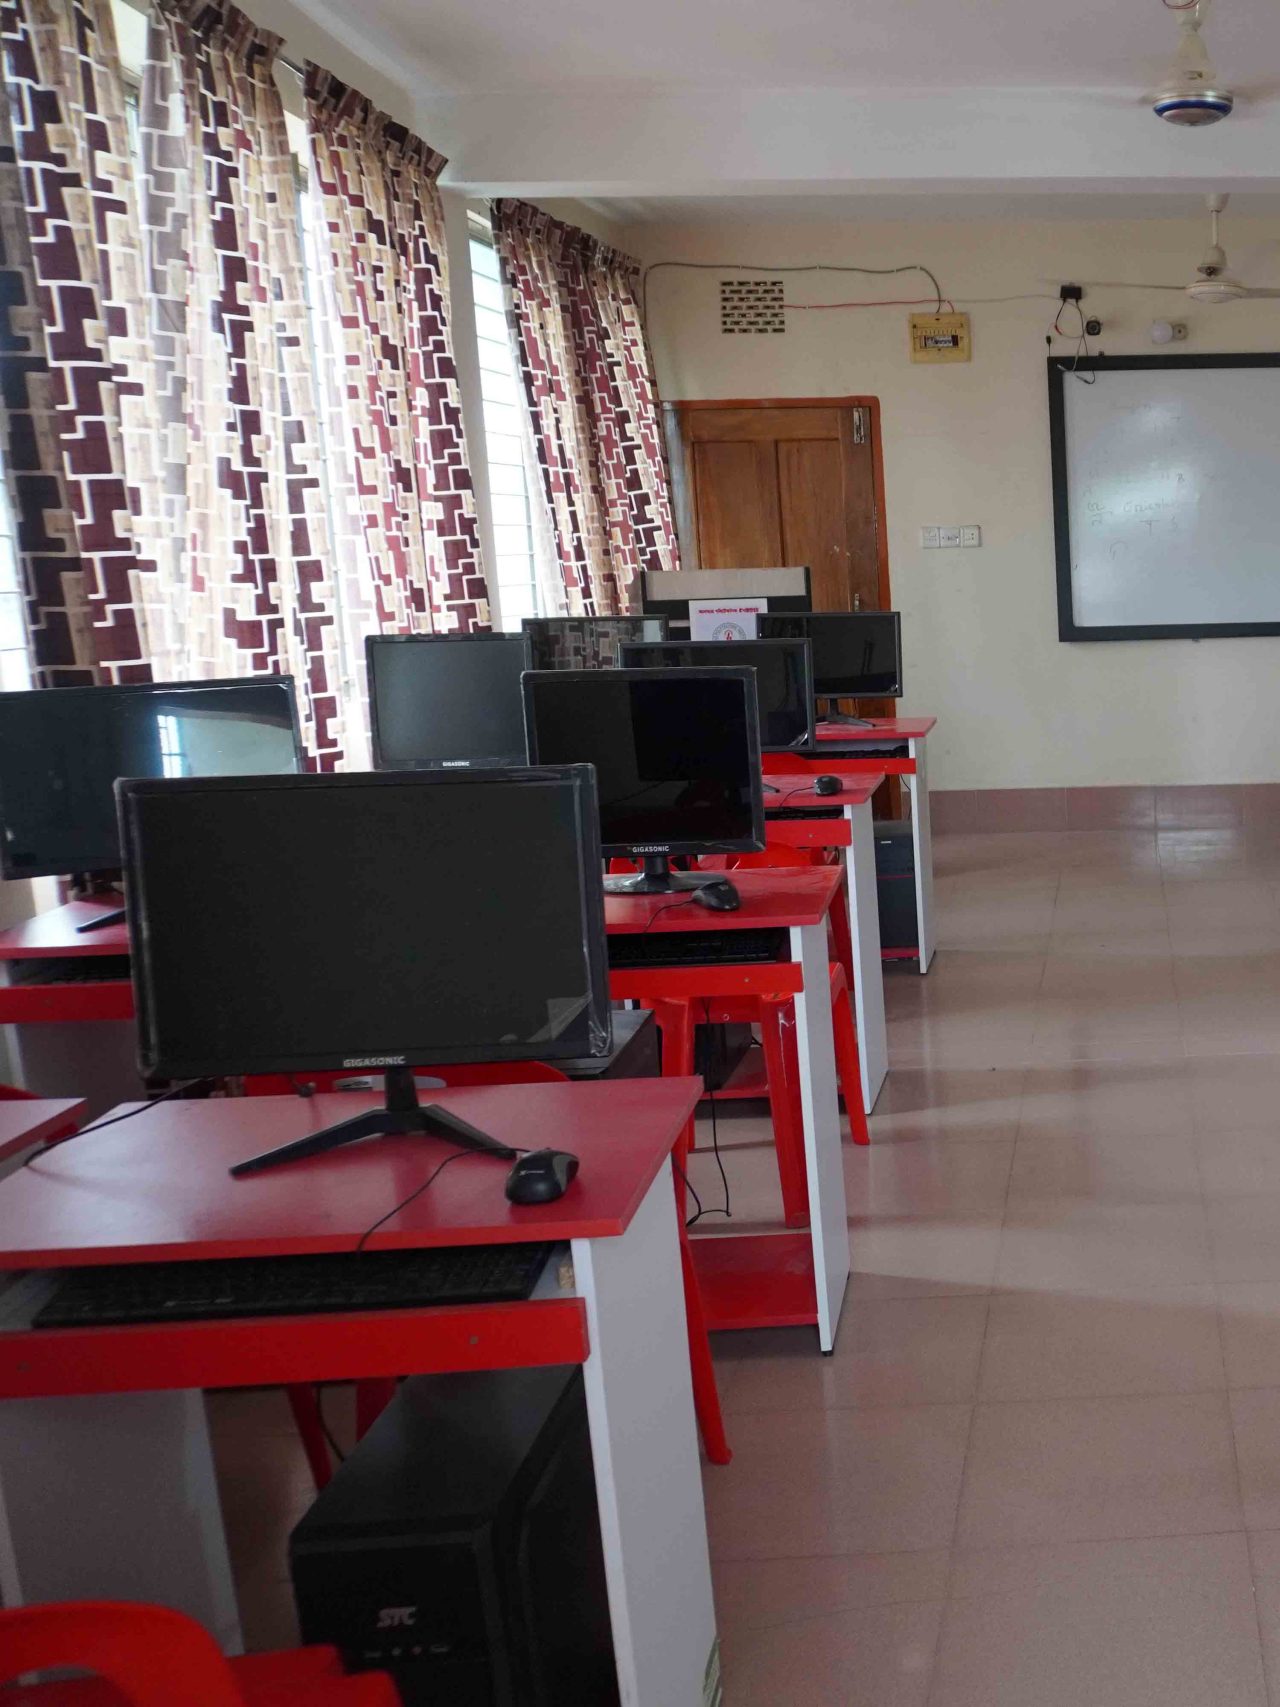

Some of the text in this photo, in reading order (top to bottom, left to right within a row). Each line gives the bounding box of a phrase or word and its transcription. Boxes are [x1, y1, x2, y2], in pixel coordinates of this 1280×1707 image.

[632, 845, 670, 853] GIGASONIC
[343, 1056, 406, 1067] GIGASONIC
[376, 1606, 417, 1628] STC
